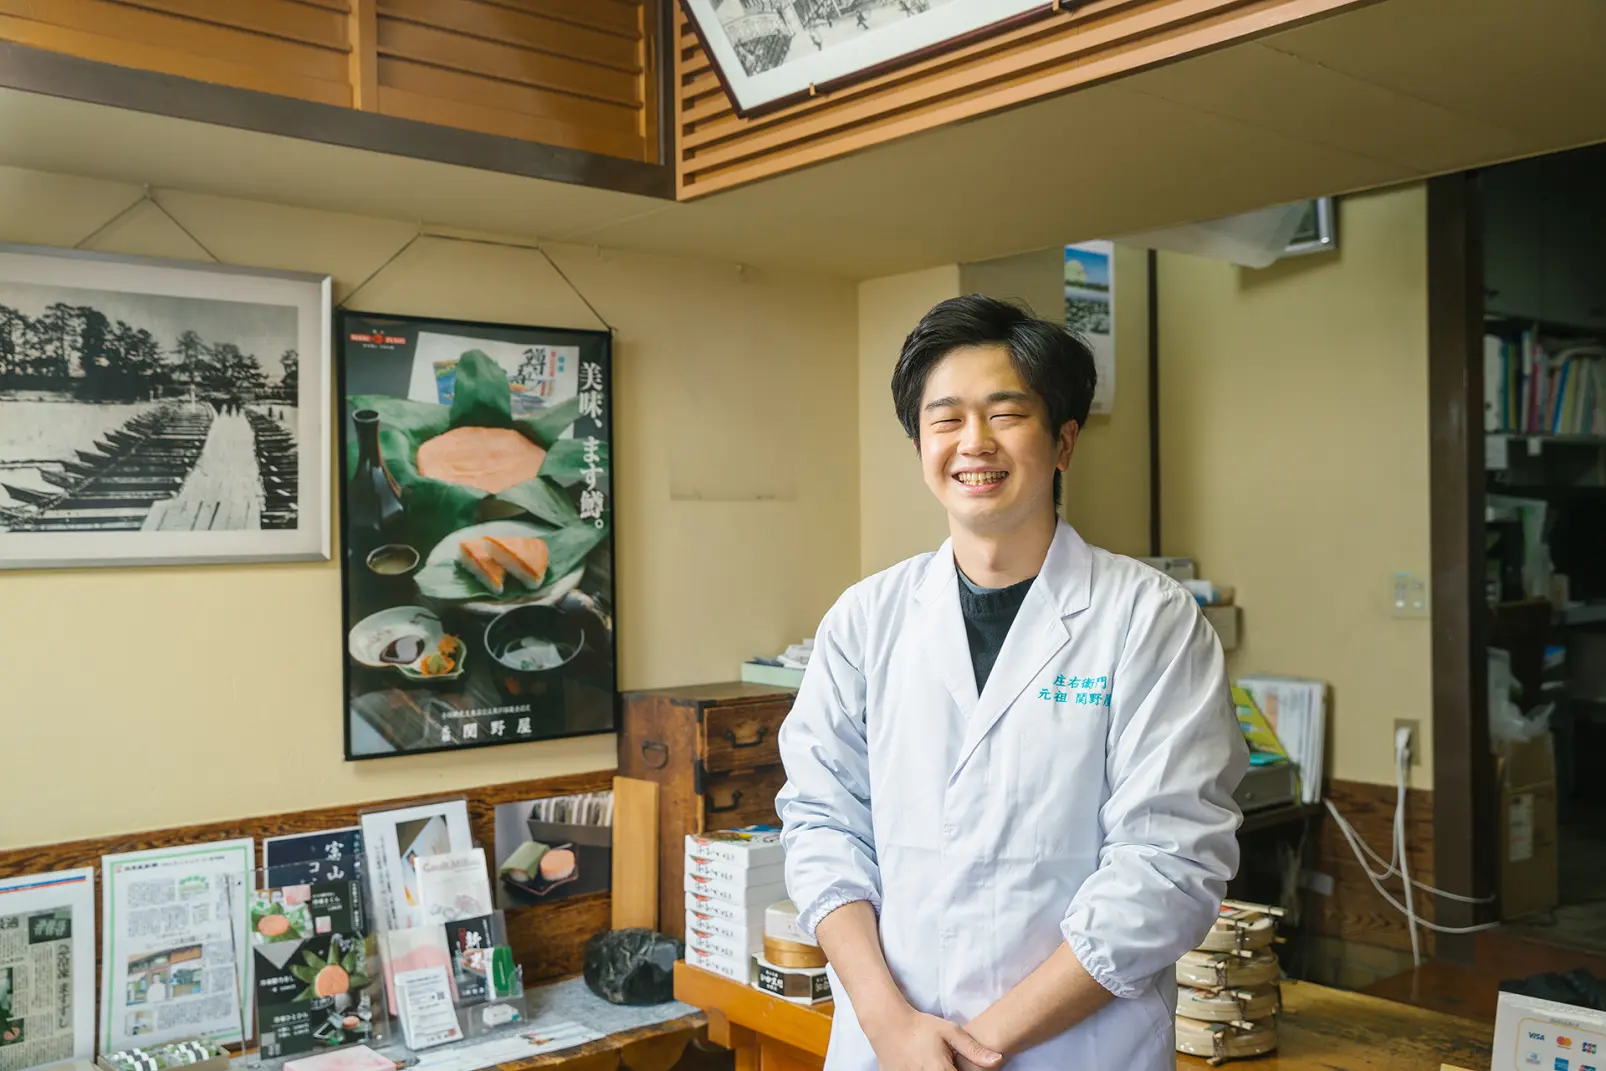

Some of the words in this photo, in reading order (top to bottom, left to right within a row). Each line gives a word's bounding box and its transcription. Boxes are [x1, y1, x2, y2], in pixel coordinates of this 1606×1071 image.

[1053, 674, 1107, 690] 庄右衛門
[1038, 688, 1068, 703] 元祖
[1528, 1031, 1545, 1041] VISA
[1582, 1041, 1597, 1054] JCB
